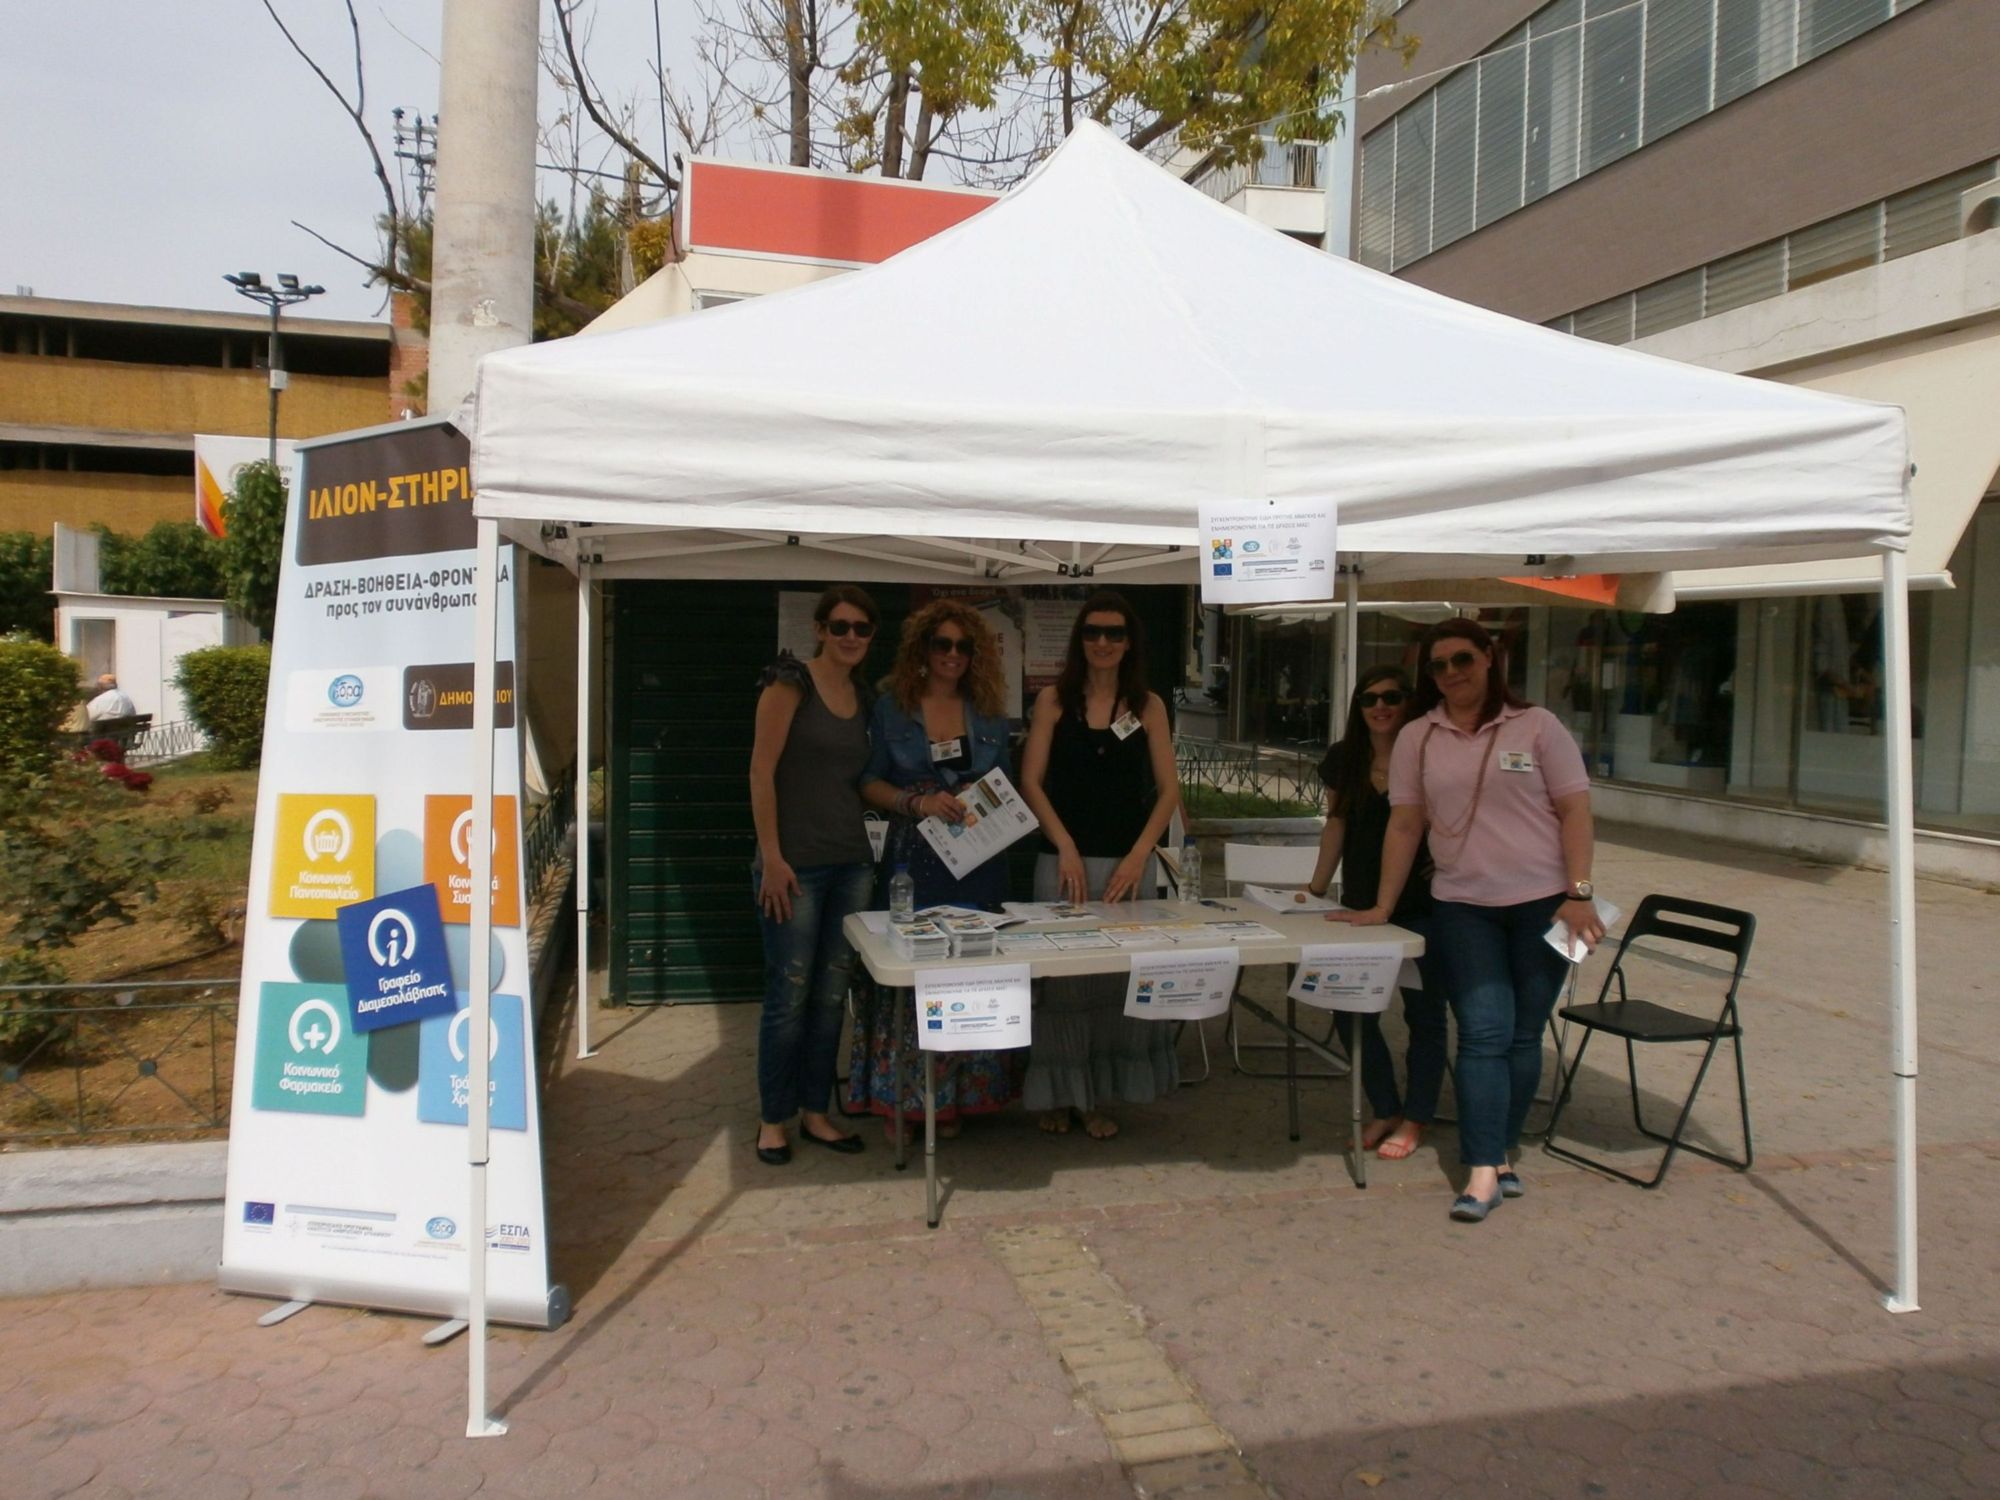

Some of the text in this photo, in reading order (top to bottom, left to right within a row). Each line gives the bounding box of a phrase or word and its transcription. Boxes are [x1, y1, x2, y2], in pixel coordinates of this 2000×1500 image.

[309, 467, 476, 519] ΙΛΙΟΝ-ΣΤΗΡΙ
[326, 602, 358, 620] προς
[362, 601, 382, 614] τον
[439, 691, 474, 706] ΔΗΜΟ
[299, 870, 353, 884] Κοινωνικό
[289, 885, 360, 900] Παντοπωλείο
[378, 971, 421, 992] Γραφείο
[357, 983, 447, 1014] Διαμεσολάβησης
[283, 1062, 341, 1079] Κοινωνικό
[278, 1078, 342, 1095] Φαρμακείο
[500, 1224, 530, 1237] ΕΣΠΑ
